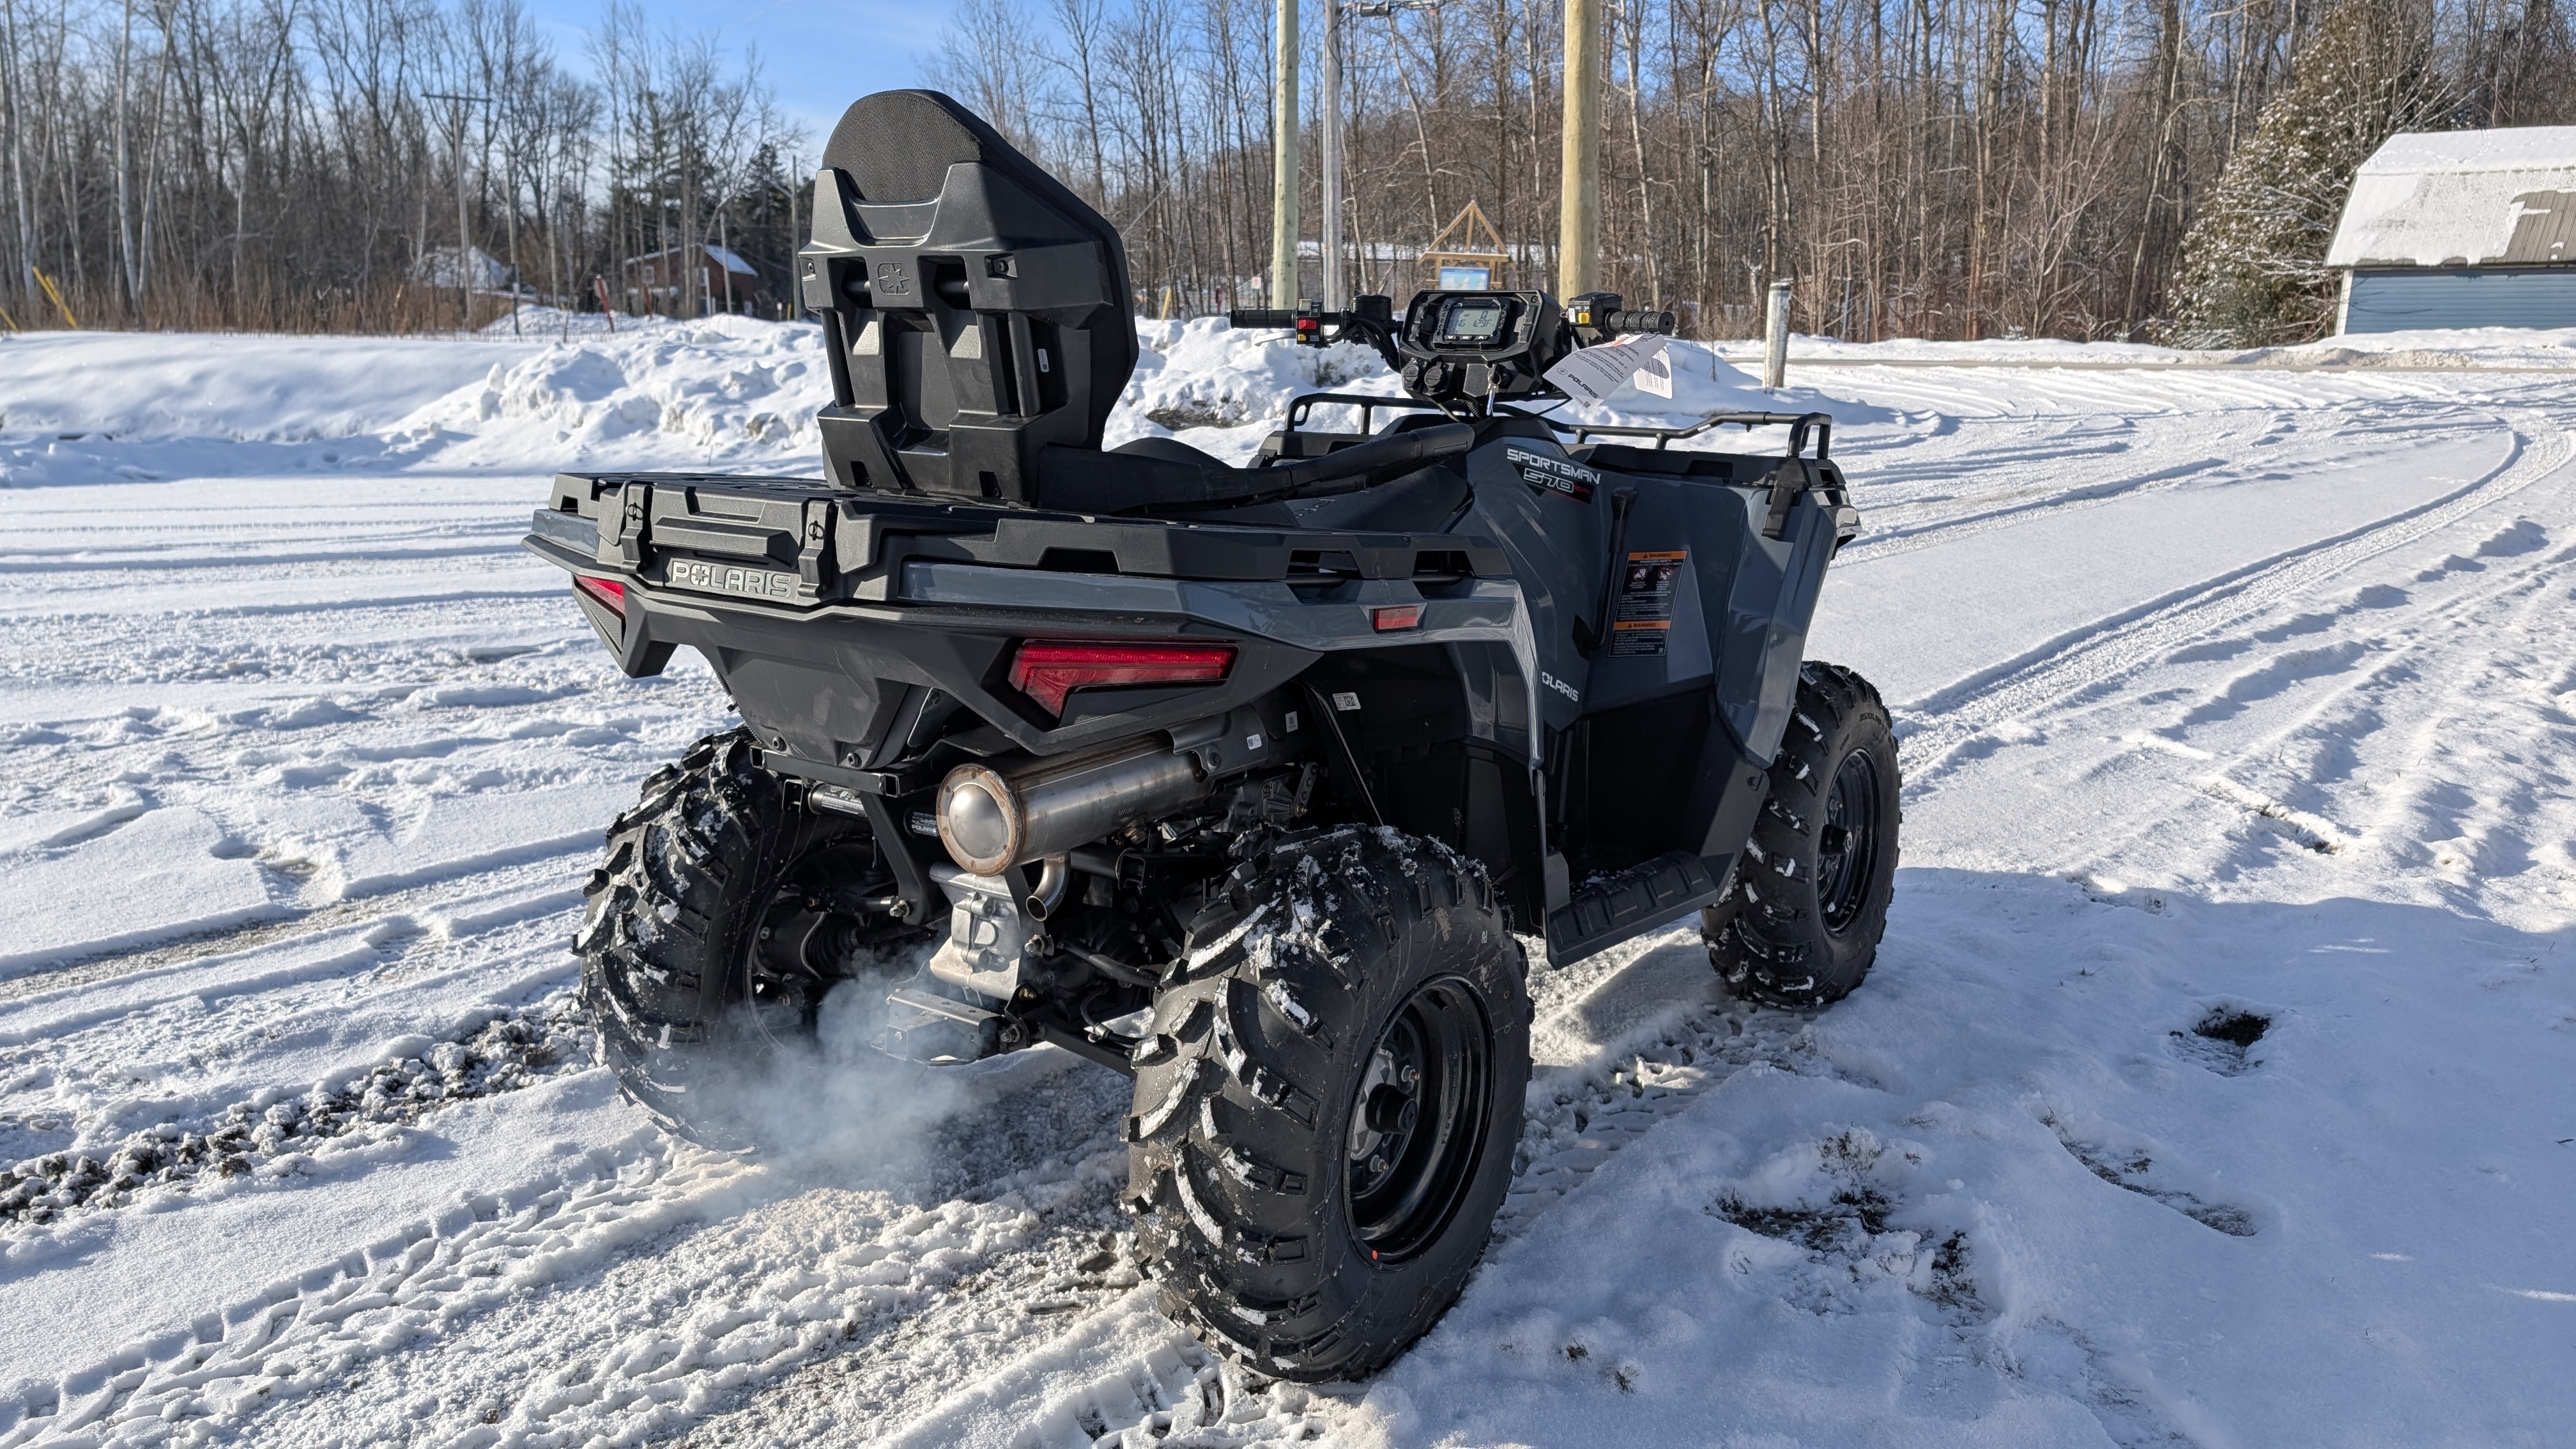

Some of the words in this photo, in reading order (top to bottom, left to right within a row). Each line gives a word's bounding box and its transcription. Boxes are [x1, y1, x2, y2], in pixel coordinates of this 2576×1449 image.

[1567, 374, 1600, 399] POLARIS
[1506, 448, 1602, 484] SPORTSMAN
[1523, 467, 1574, 493] 570
[672, 561, 791, 598] POLARIS
[1542, 671, 1579, 702] OLARIS
